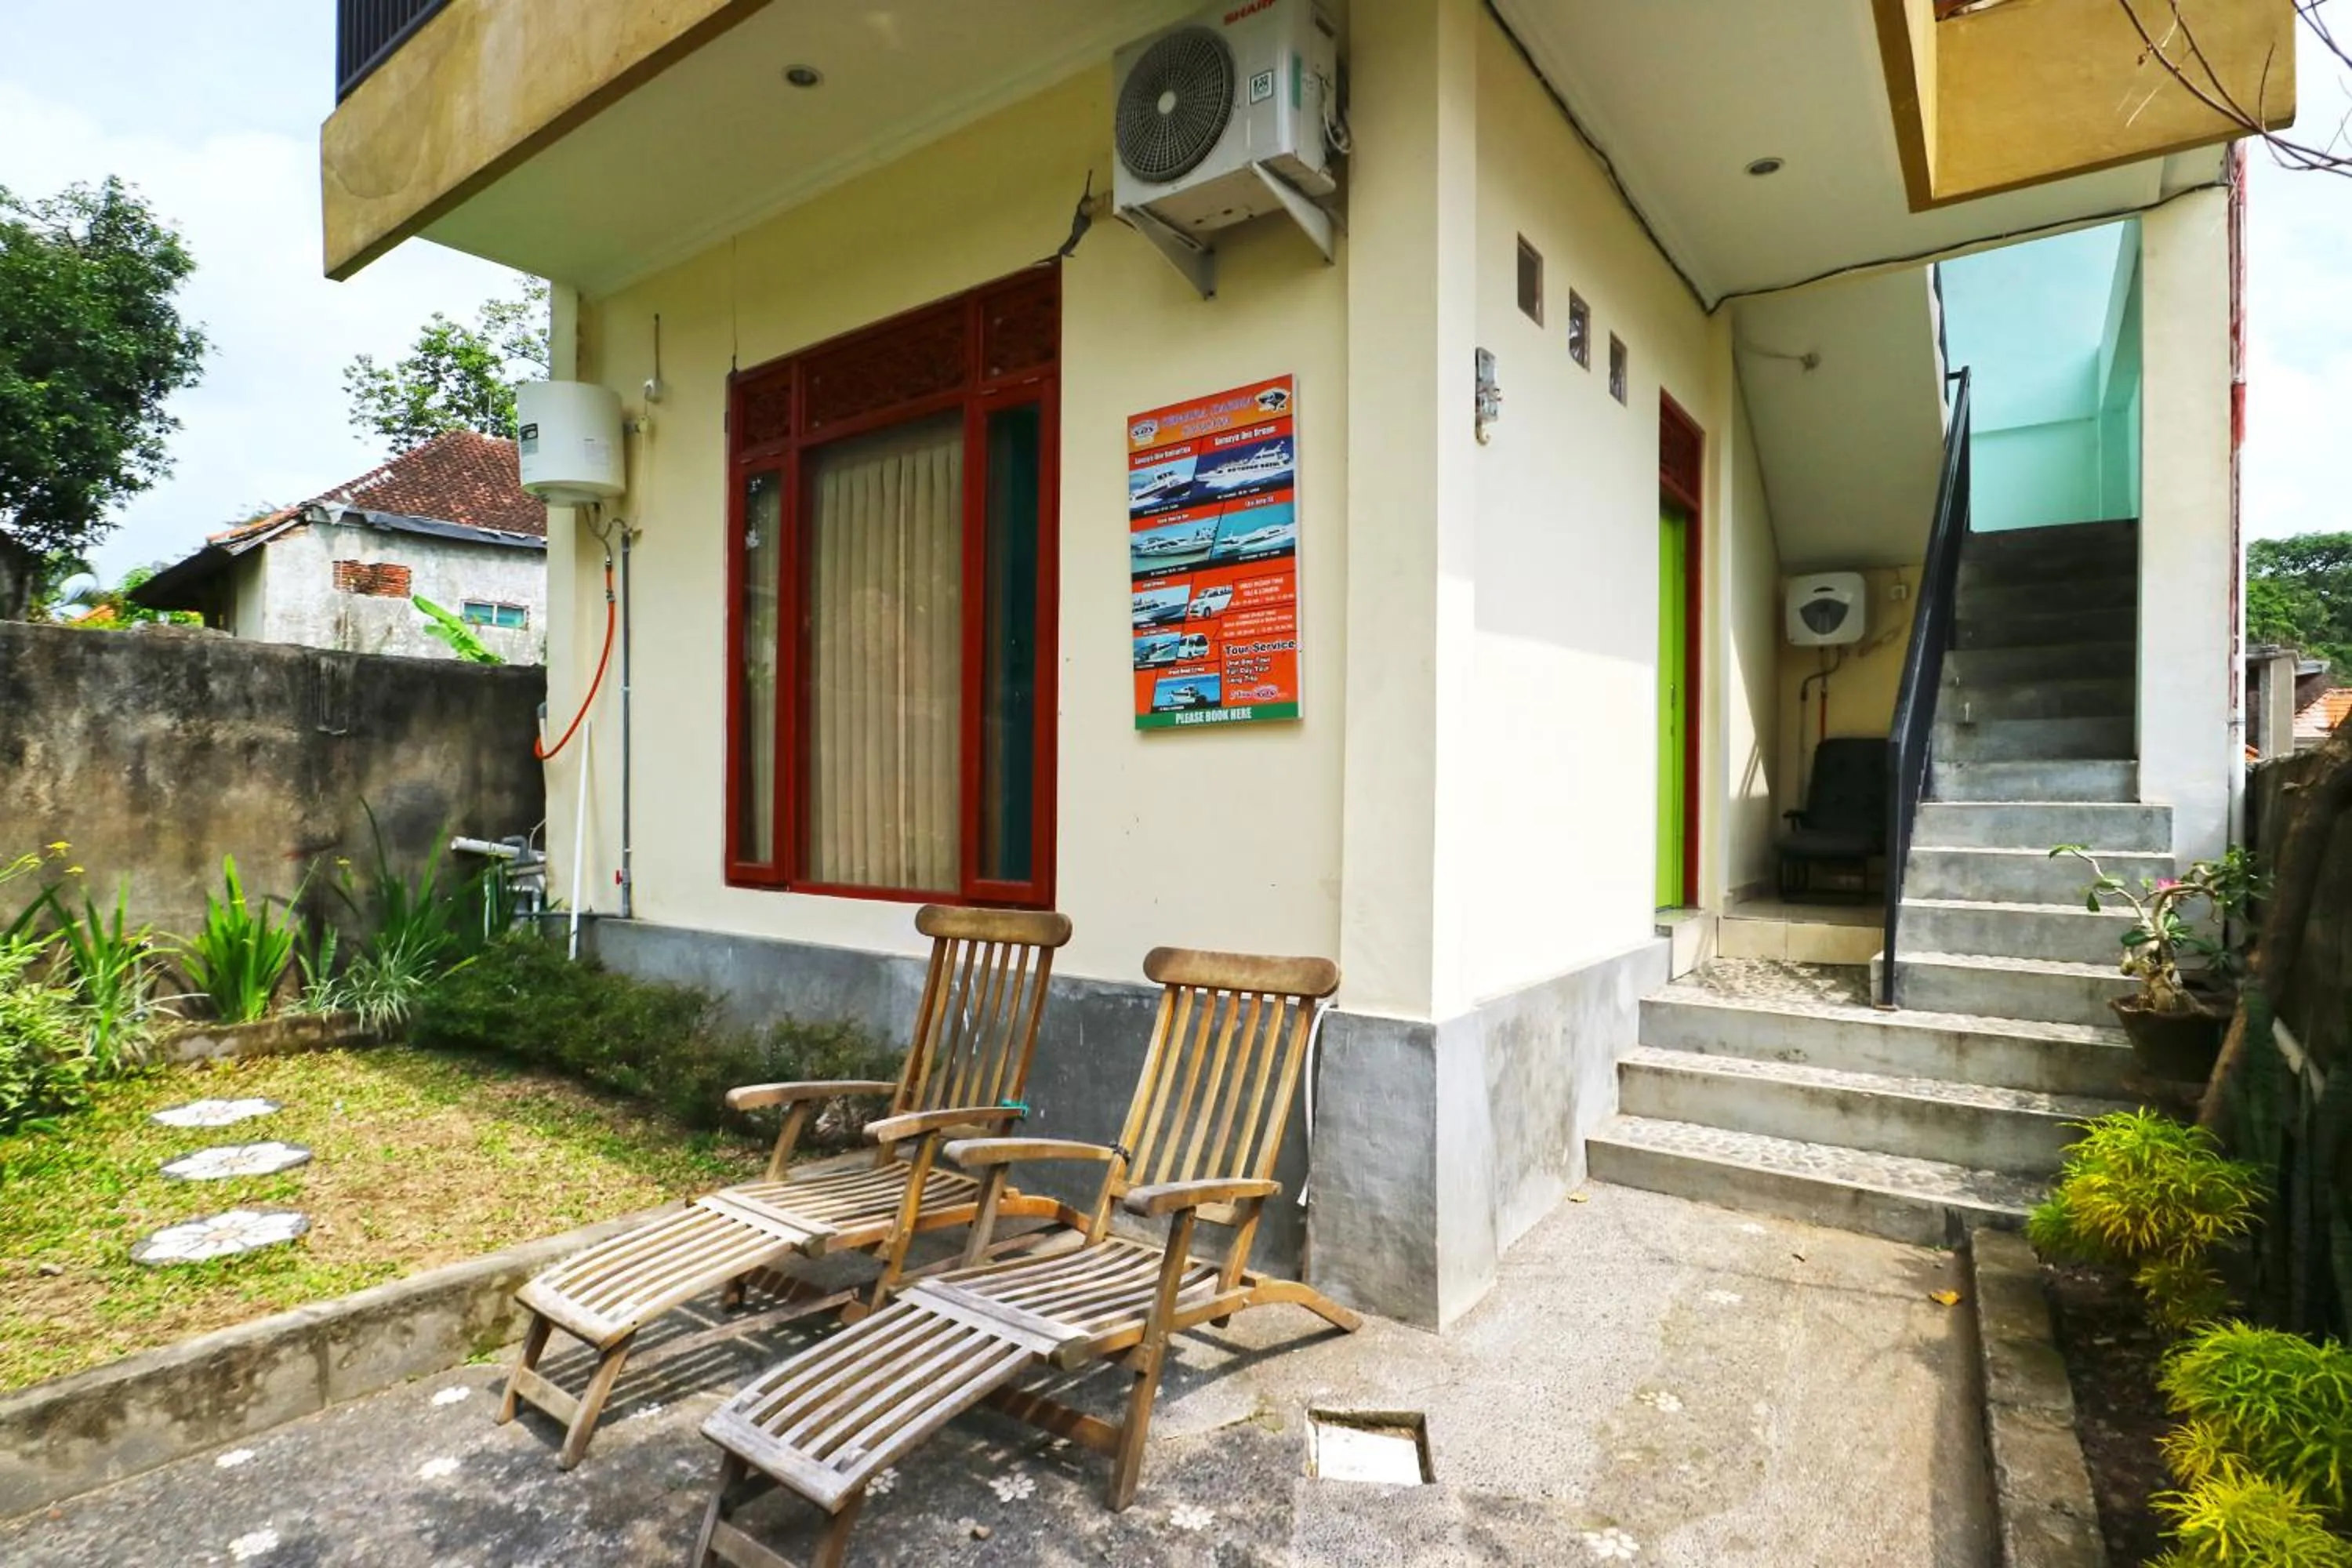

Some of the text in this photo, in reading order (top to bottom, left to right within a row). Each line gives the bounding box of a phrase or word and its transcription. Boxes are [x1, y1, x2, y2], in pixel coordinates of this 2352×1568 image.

[1225, 640, 1295, 655] Tour Service
[1176, 707, 1252, 724] PLEASE BOOK HERE
